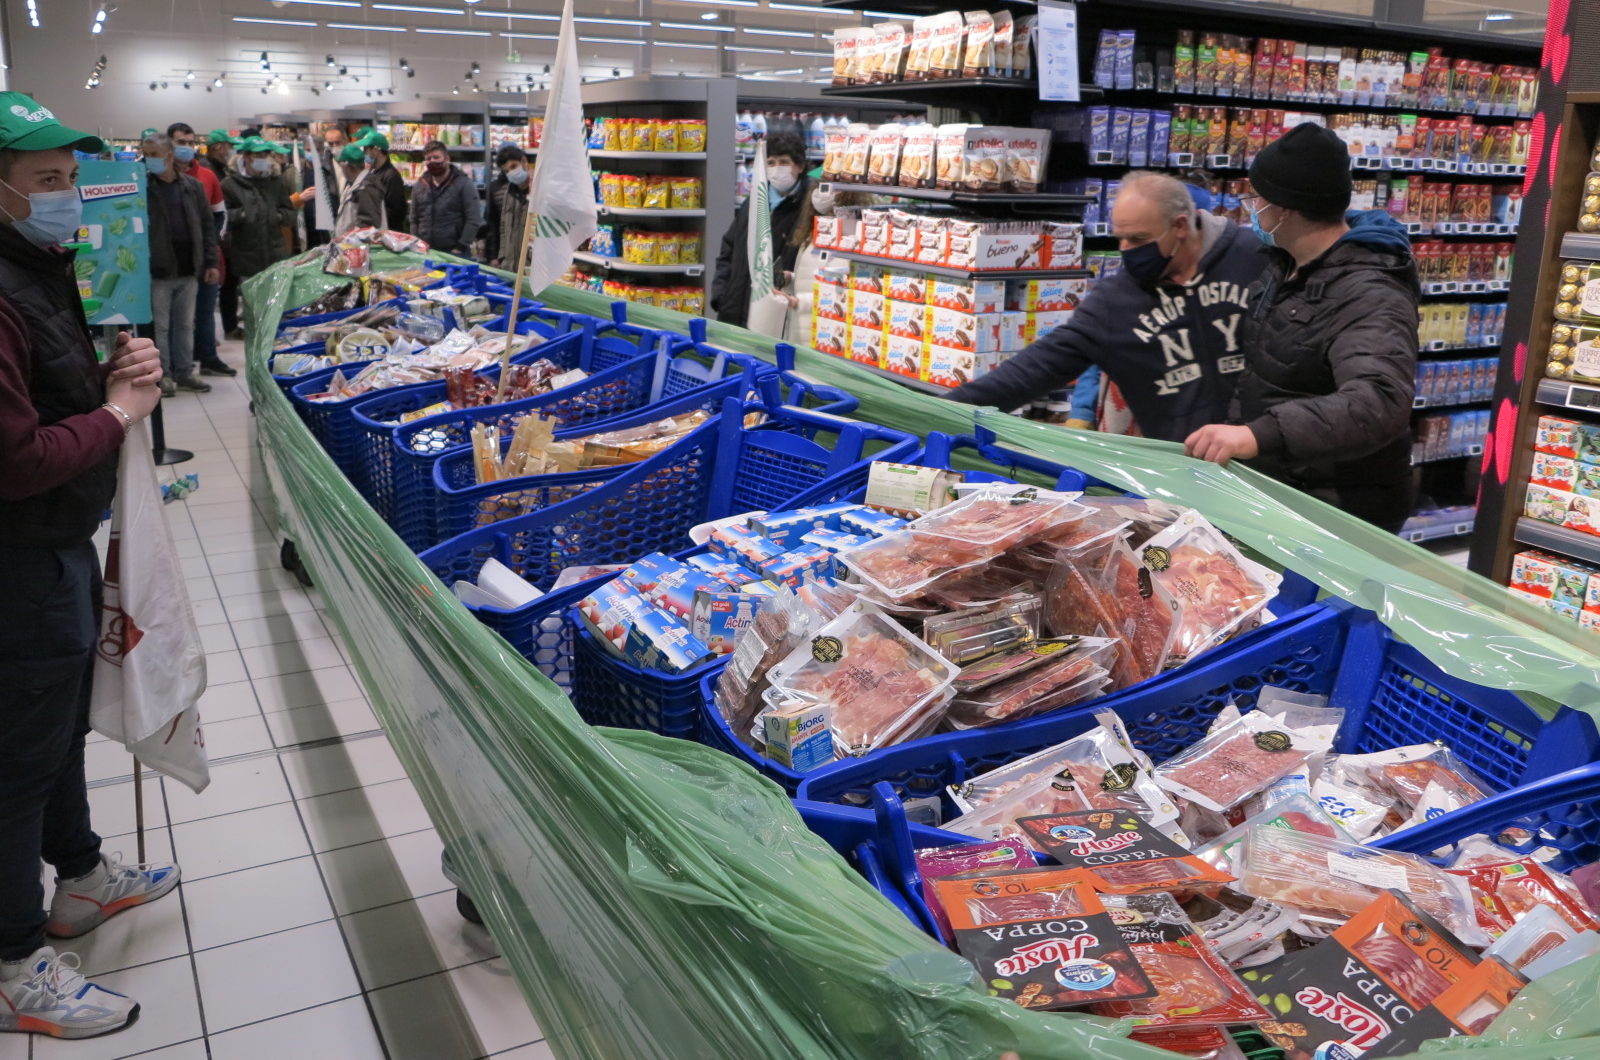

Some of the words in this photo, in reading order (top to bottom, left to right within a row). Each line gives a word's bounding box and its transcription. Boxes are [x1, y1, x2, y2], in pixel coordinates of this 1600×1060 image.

[967, 136, 1003, 150] nutella
[1008, 138, 1038, 150] utella
[84, 184, 136, 196] HOLLYWOOD
[986, 244, 1018, 258] bueno
[1198, 281, 1248, 308] OSTAL
[1157, 328, 1194, 367] N
[1211, 313, 1242, 352] Y
[634, 650, 651, 668] Acti
[1084, 850, 1168, 865] COPPA
[982, 920, 1088, 941] COPPA
[1122, 930, 1165, 942] agnol
[1426, 948, 1450, 970] 10
[1343, 956, 1414, 1024] OPPA
